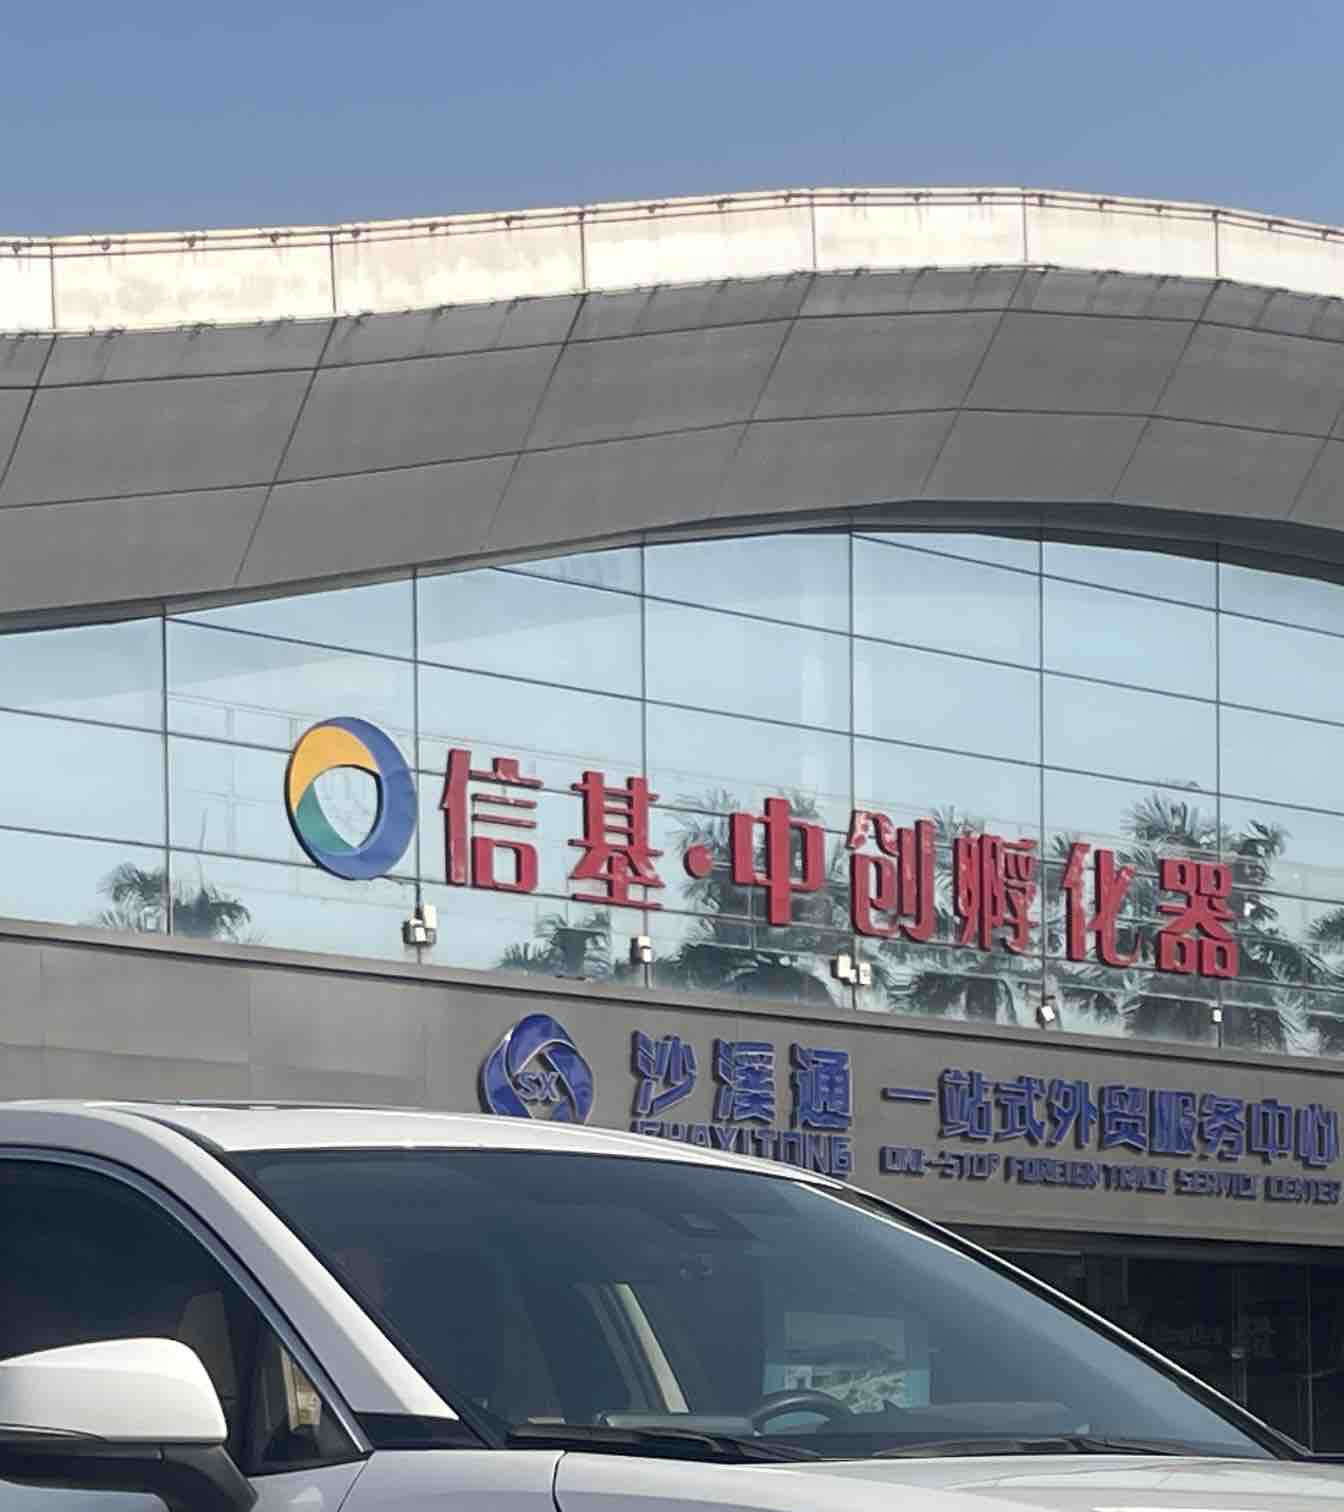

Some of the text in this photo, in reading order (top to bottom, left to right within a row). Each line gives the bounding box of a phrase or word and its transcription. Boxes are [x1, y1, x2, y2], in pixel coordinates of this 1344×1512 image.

[632, 1030, 854, 1129] 沙溪通
[880, 1069, 1342, 1169] 一站式外贸服务中心
